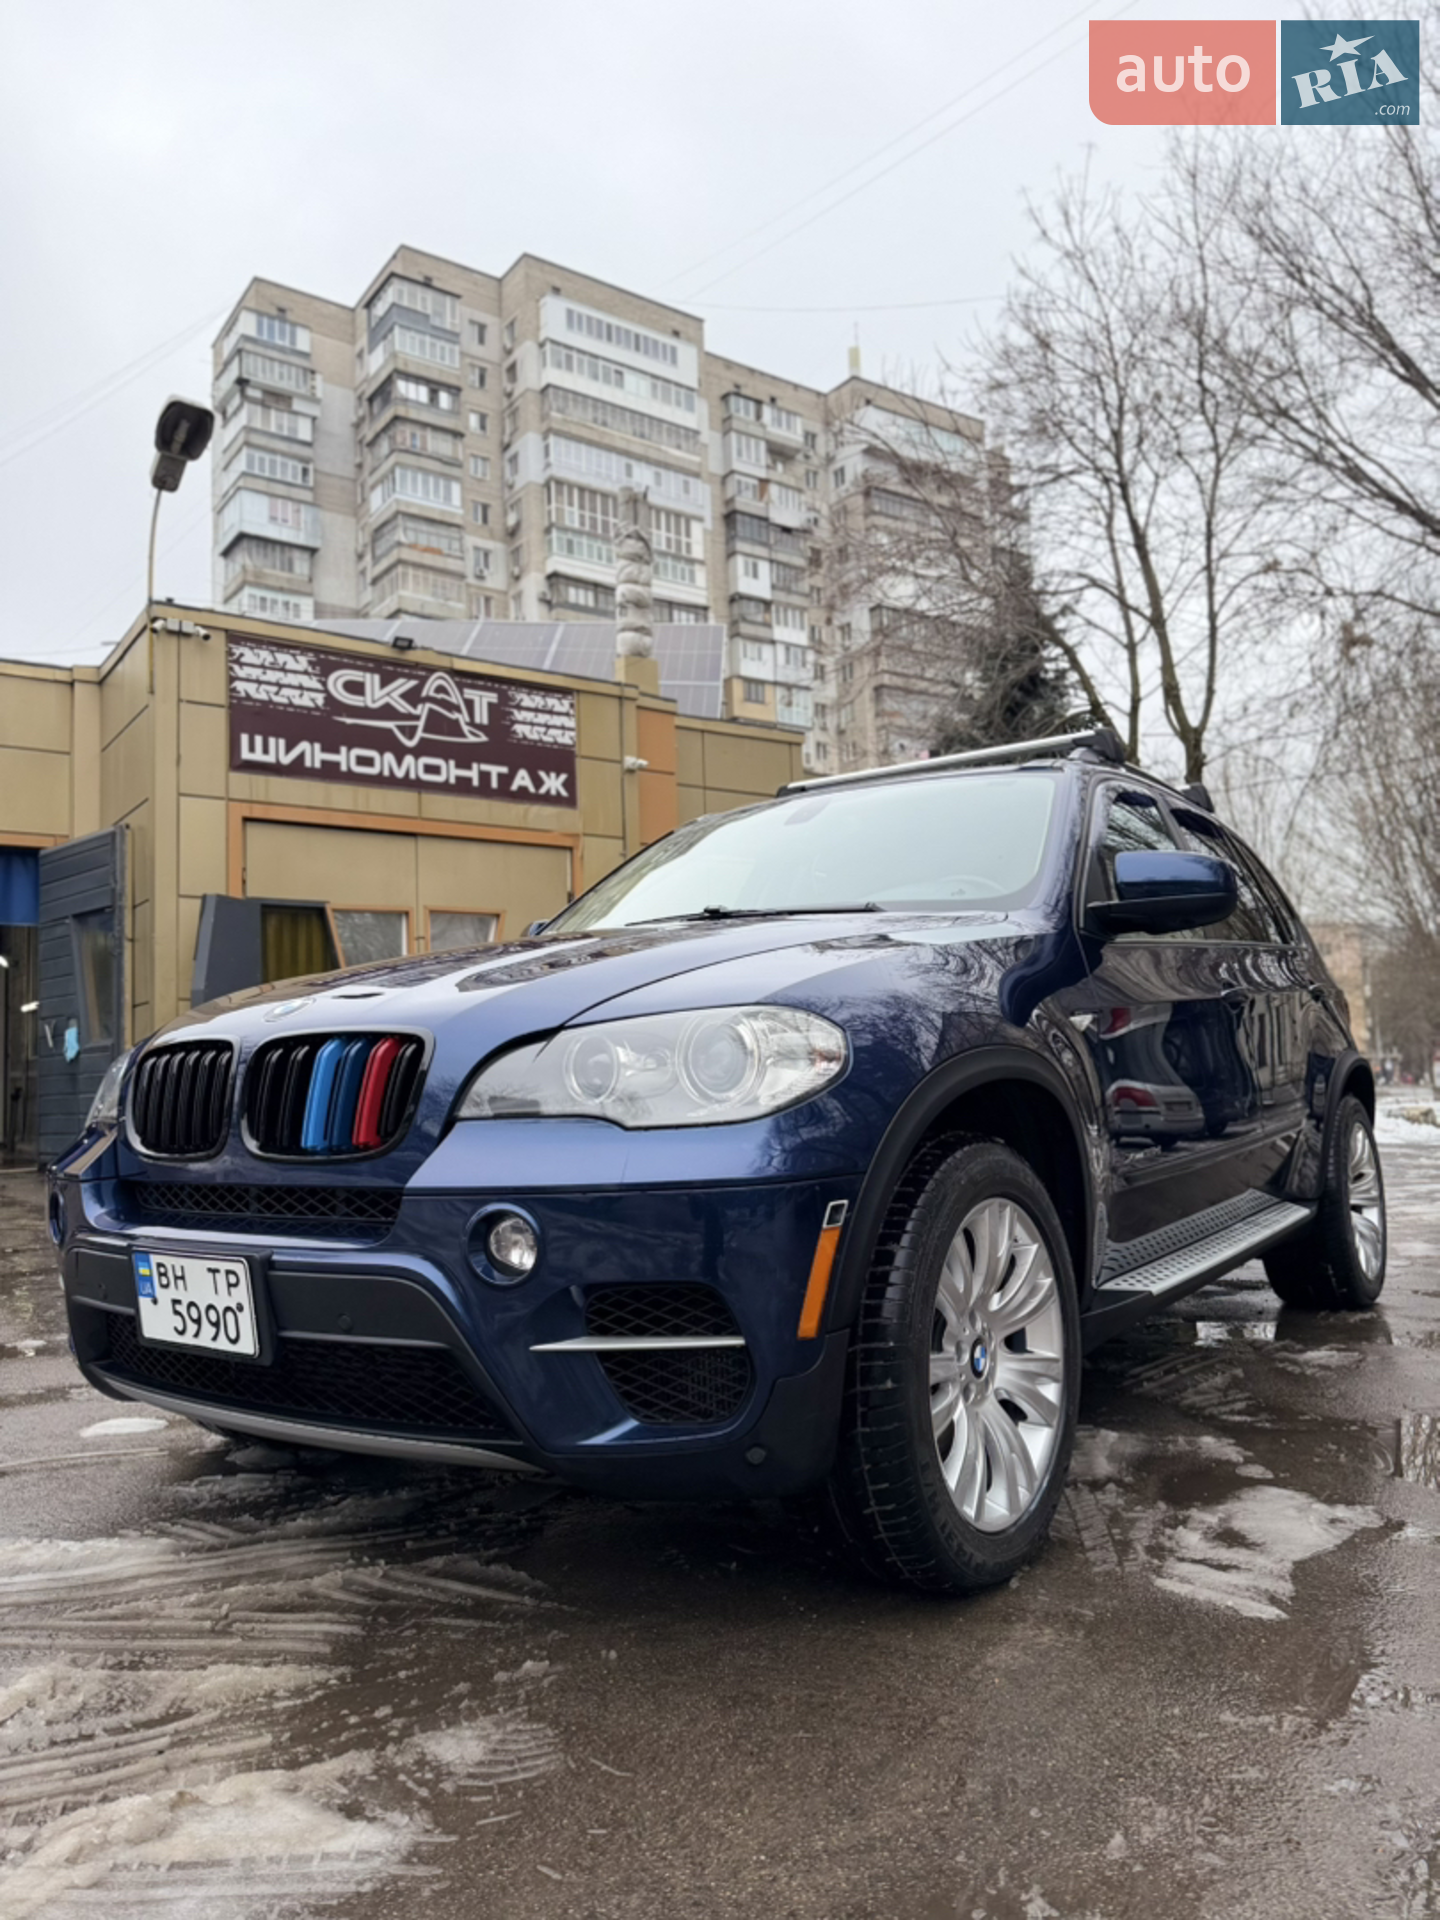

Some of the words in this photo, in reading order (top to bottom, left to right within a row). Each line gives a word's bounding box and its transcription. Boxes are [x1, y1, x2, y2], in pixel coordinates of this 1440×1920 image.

[326, 669, 499, 726] СКАТ
[239, 733, 570, 798] ШИНОМОНТАЖ
[170, 1298, 241, 1346] 5990
